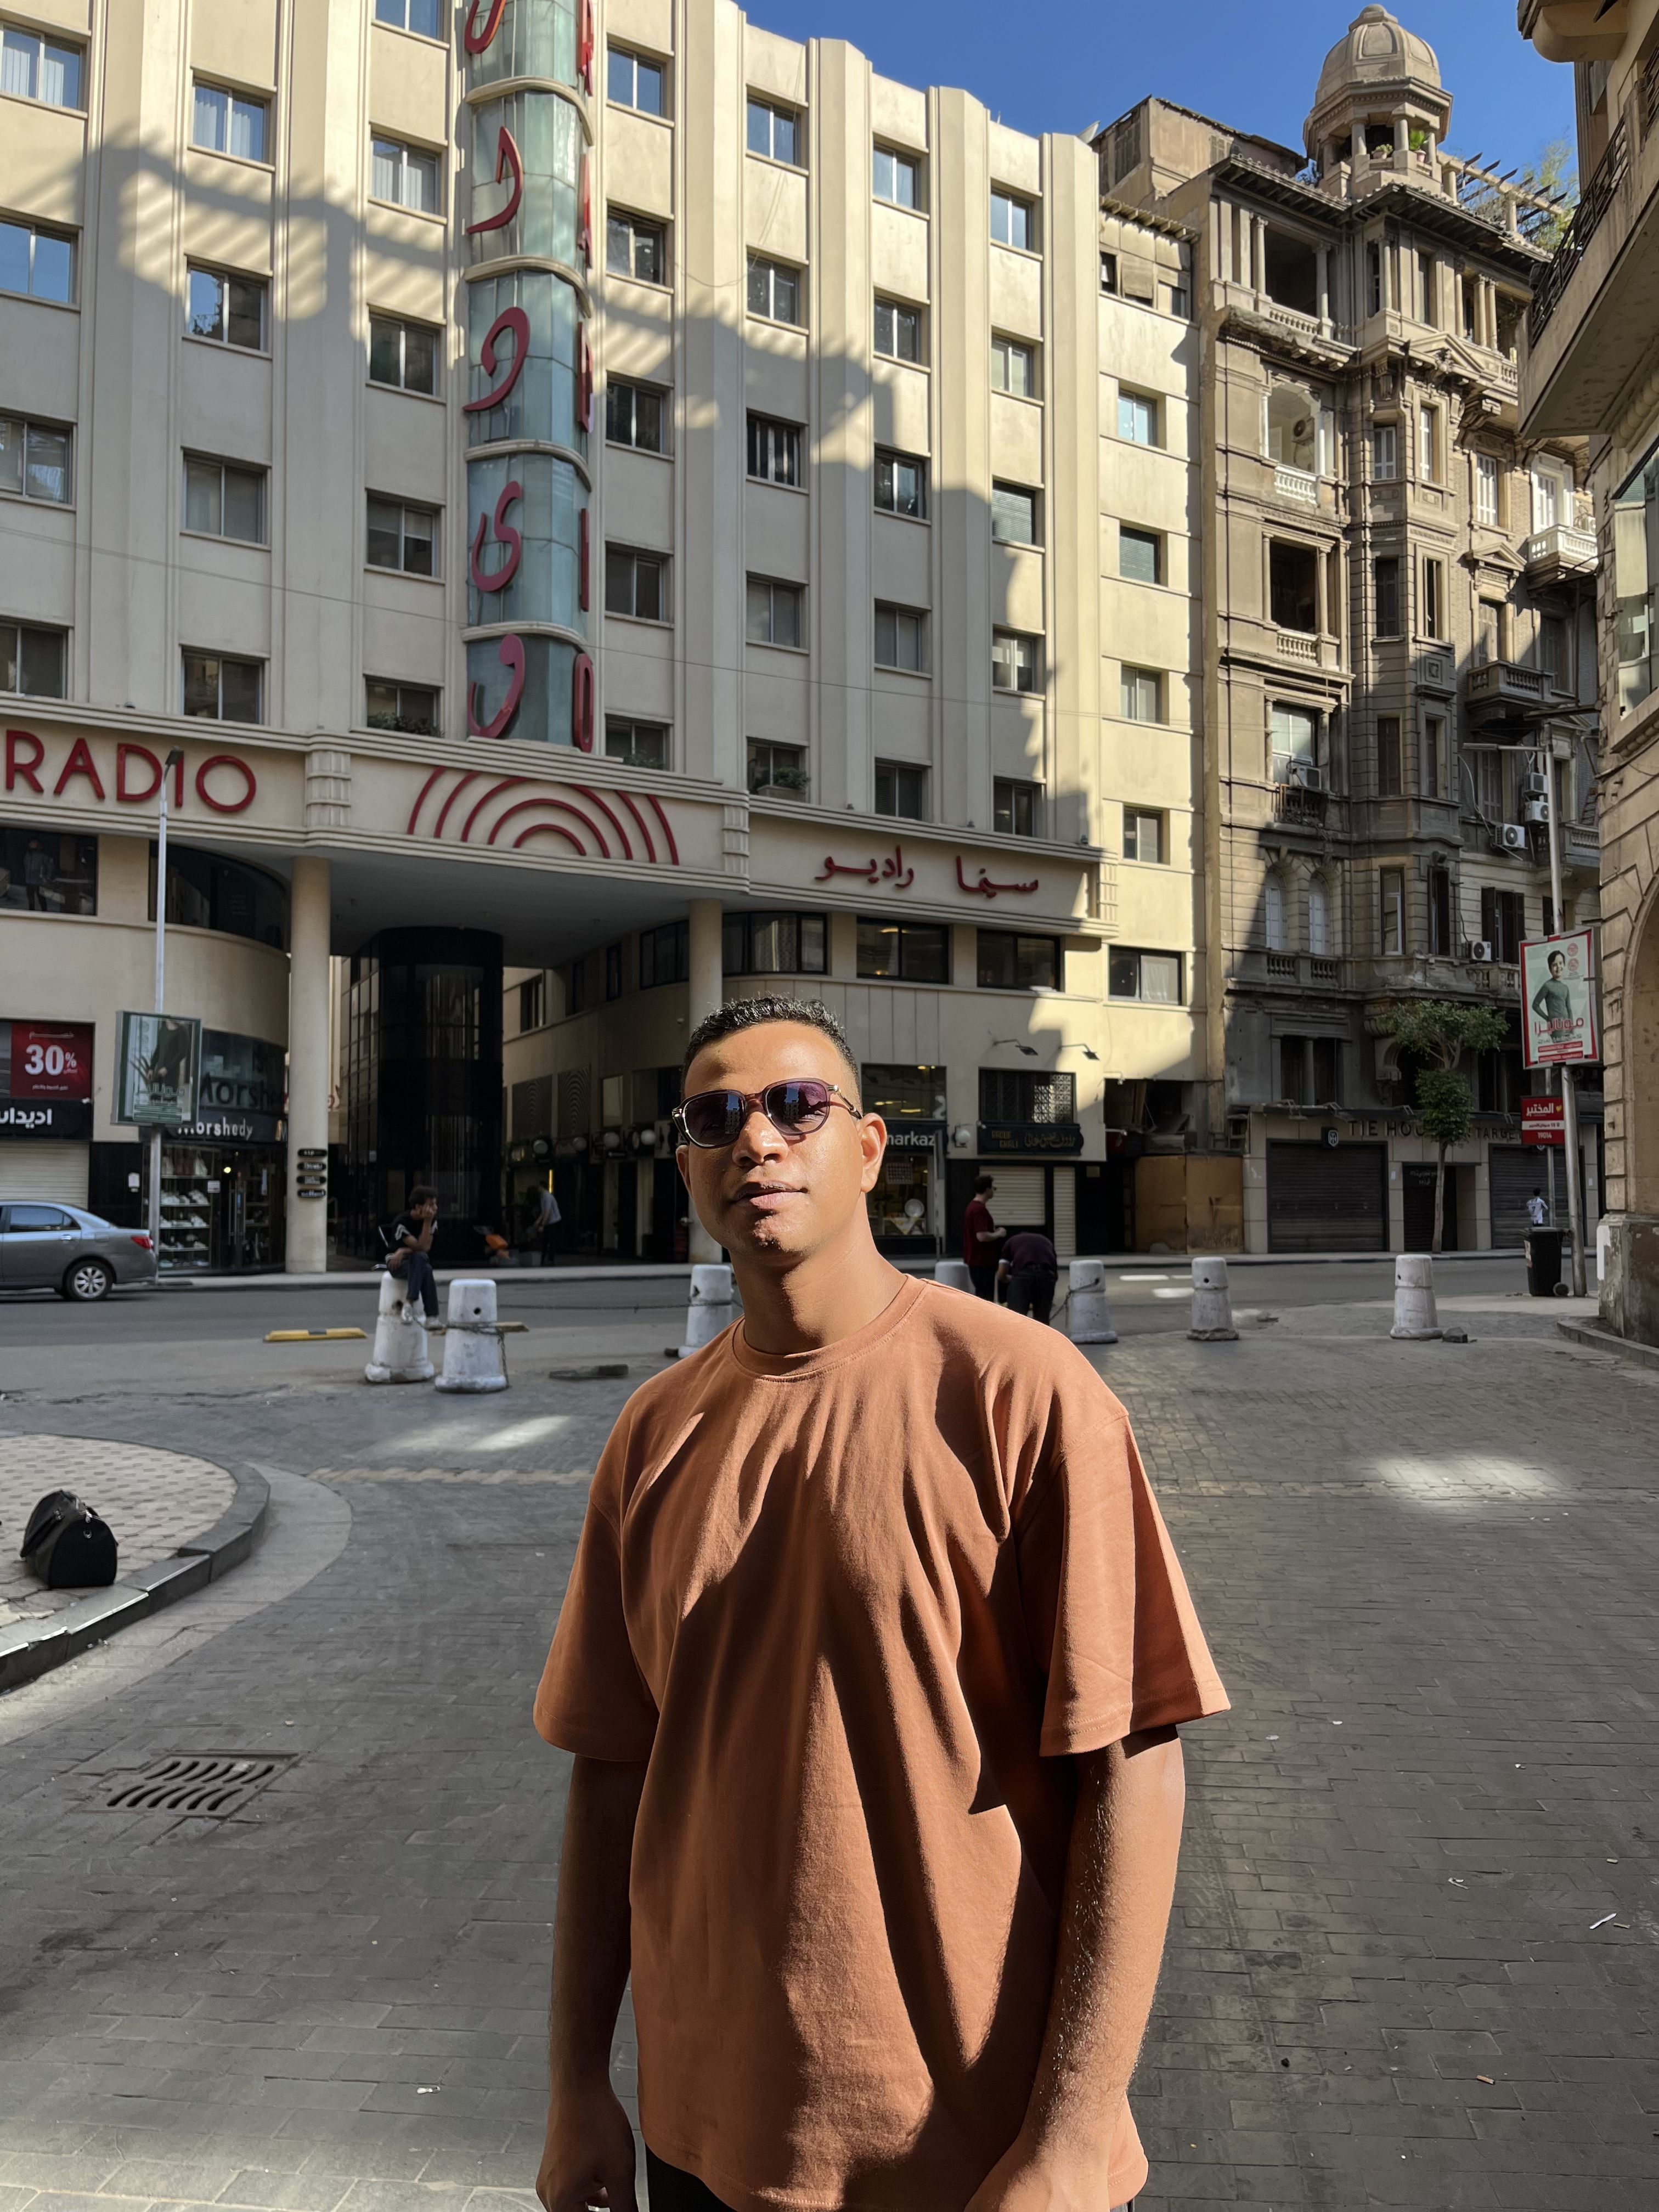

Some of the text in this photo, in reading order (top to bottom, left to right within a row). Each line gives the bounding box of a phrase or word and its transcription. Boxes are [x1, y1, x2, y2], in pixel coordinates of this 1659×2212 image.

[5, 730, 257, 813] RADIO
[815, 845, 915, 888] راديو
[1534, 1018, 1584, 1037] موناليزا
[24, 1043, 77, 1076] 30%
[1526, 1102, 1554, 1117] المختبر
[178, 1116, 255, 1142] orshedy
[1348, 1120, 1378, 1137] TIE
